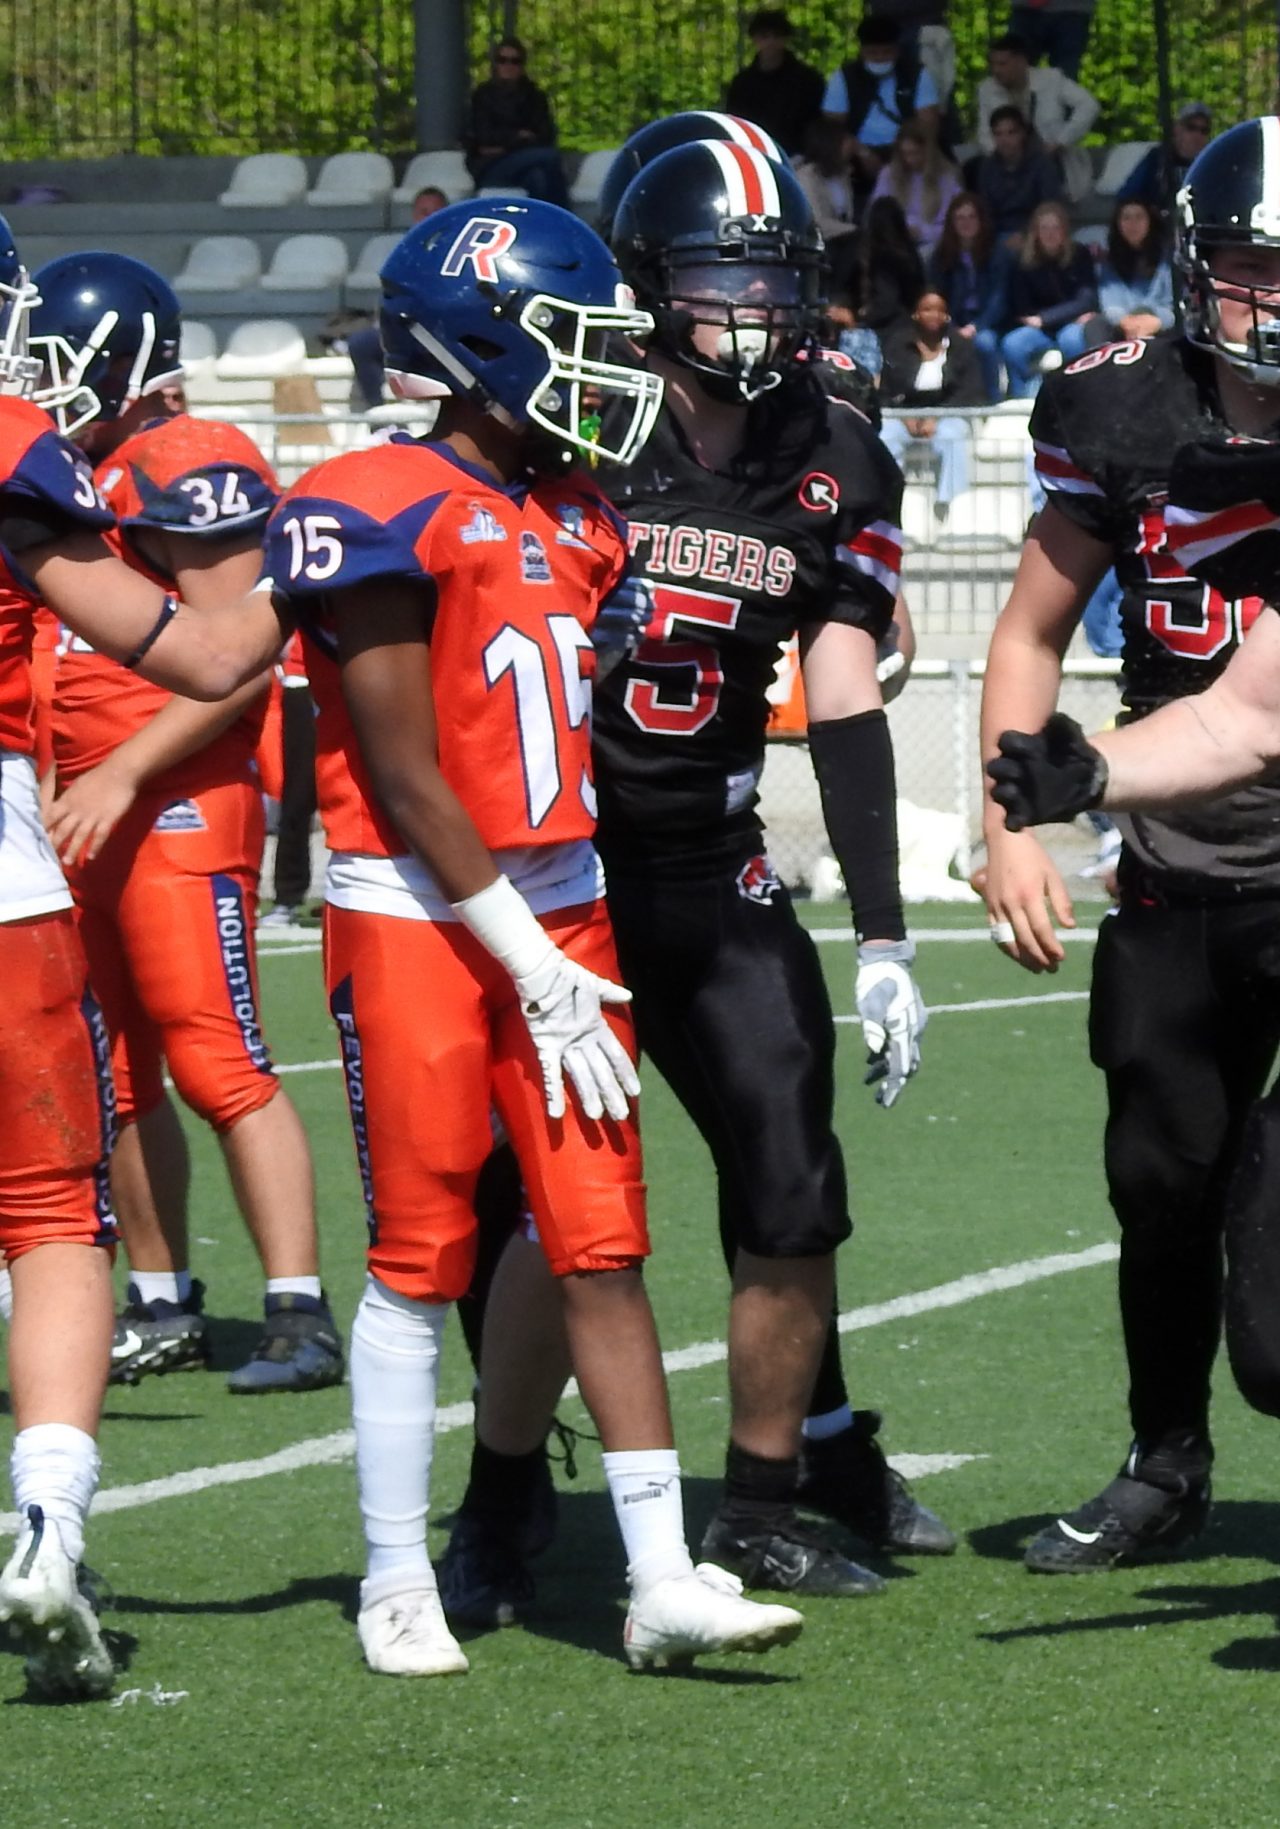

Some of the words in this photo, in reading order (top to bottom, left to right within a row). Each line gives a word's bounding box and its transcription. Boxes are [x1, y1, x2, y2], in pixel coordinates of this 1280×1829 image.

[179, 471, 251, 526] 34
[283, 514, 343, 581] 15
[626, 521, 798, 598] TIGERS
[1143, 550, 1265, 661] 5
[624, 583, 742, 736] 5
